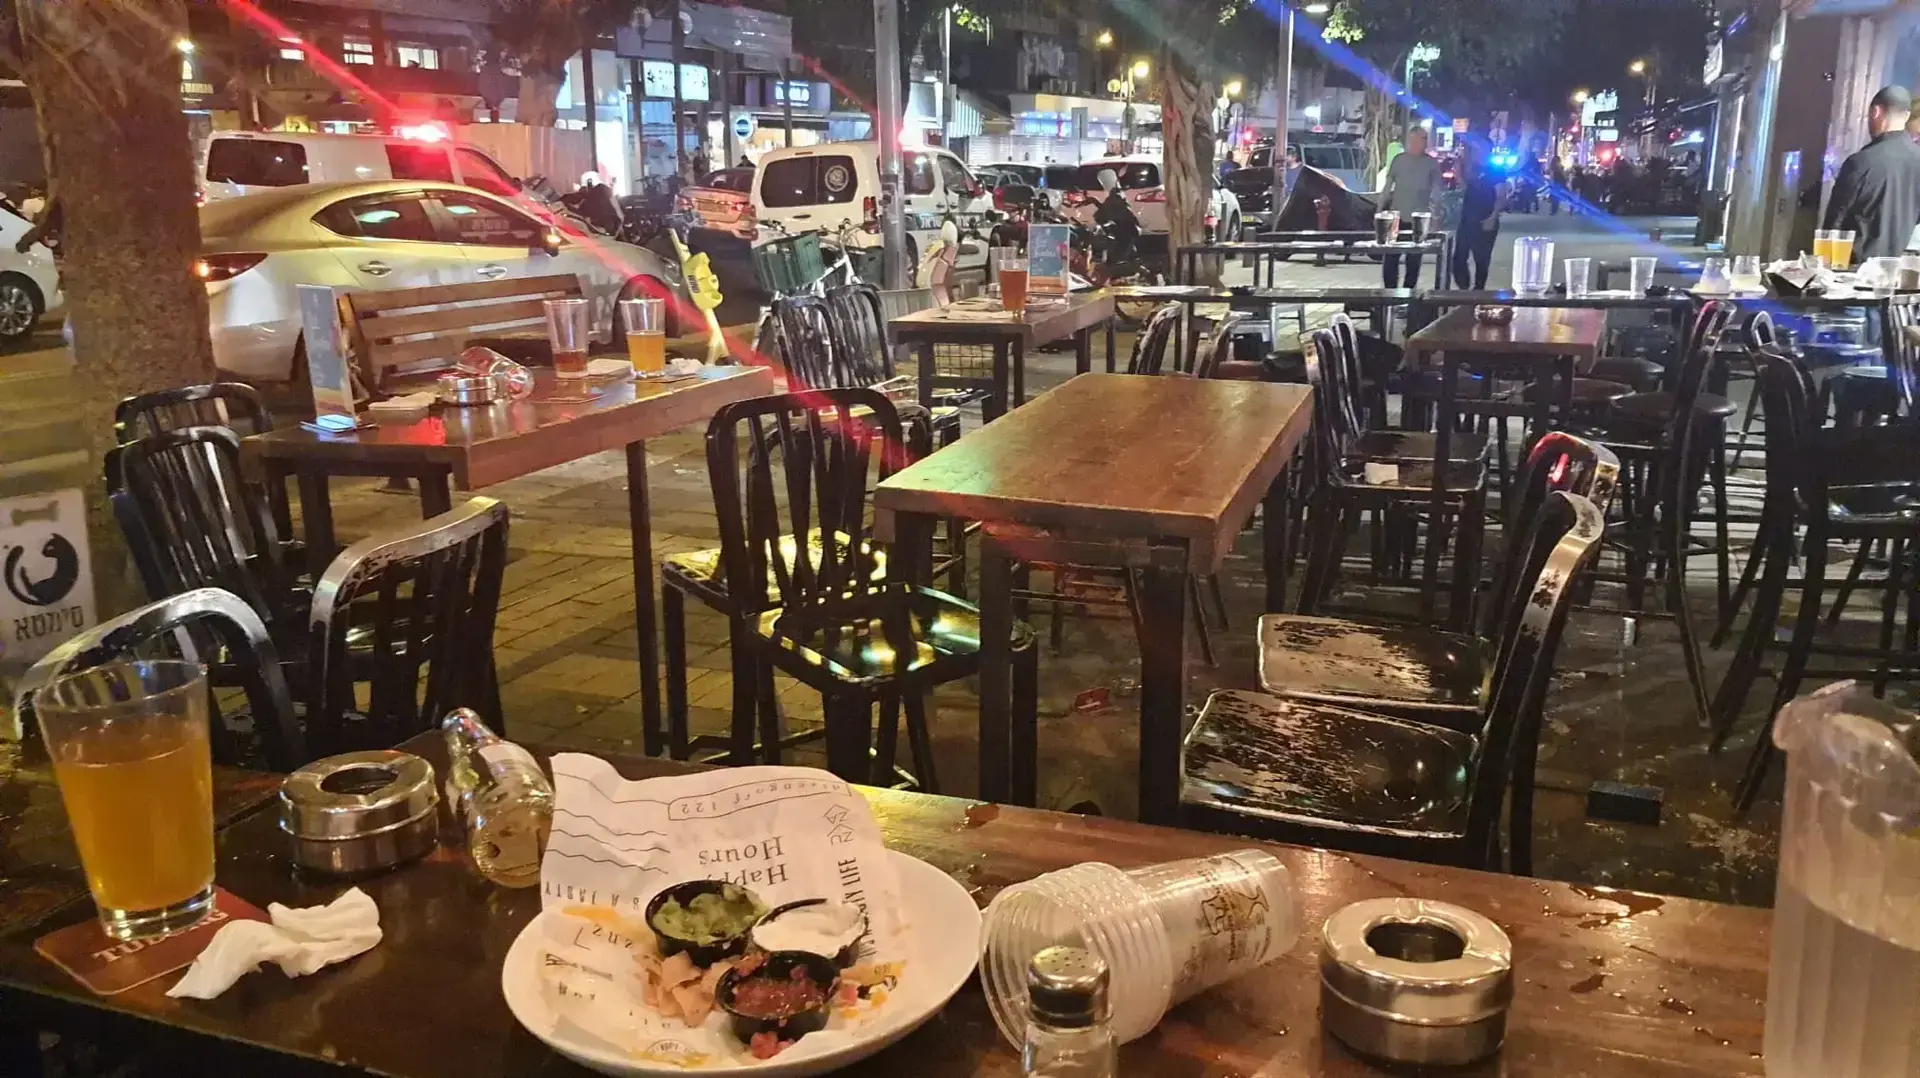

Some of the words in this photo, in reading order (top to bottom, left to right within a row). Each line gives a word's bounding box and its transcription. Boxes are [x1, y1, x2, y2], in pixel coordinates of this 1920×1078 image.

[681, 801, 718, 815] 122
[697, 836, 786, 866] Hours
[705, 862, 790, 887] Happ
[837, 856, 862, 887] LIFE
